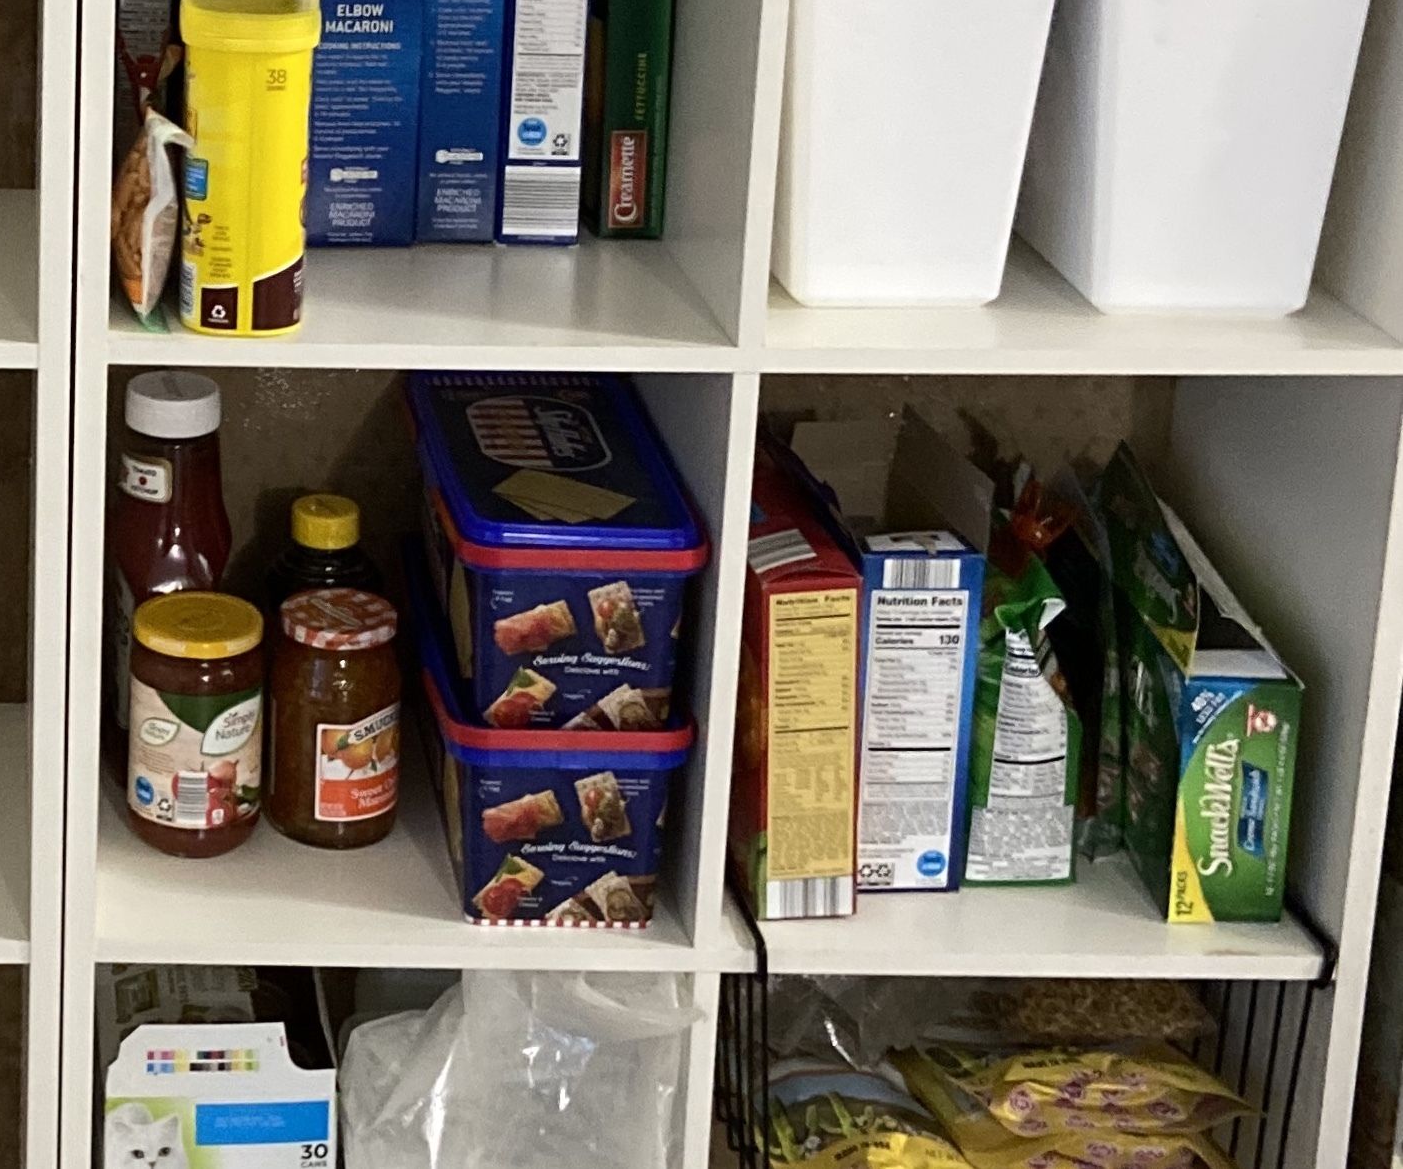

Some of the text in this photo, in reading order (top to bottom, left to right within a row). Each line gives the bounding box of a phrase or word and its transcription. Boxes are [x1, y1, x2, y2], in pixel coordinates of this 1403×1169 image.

[337, 3, 384, 17] ELBOW
[325, 19, 394, 34] MACARONI
[266, 68, 287, 85] 38
[612, 135, 638, 223] Creamette
[876, 596, 964, 607] Nutrition Facts
[938, 634, 961, 646] 130
[1174, 899, 1195, 917] 12
[300, 1142, 329, 1161] 30
